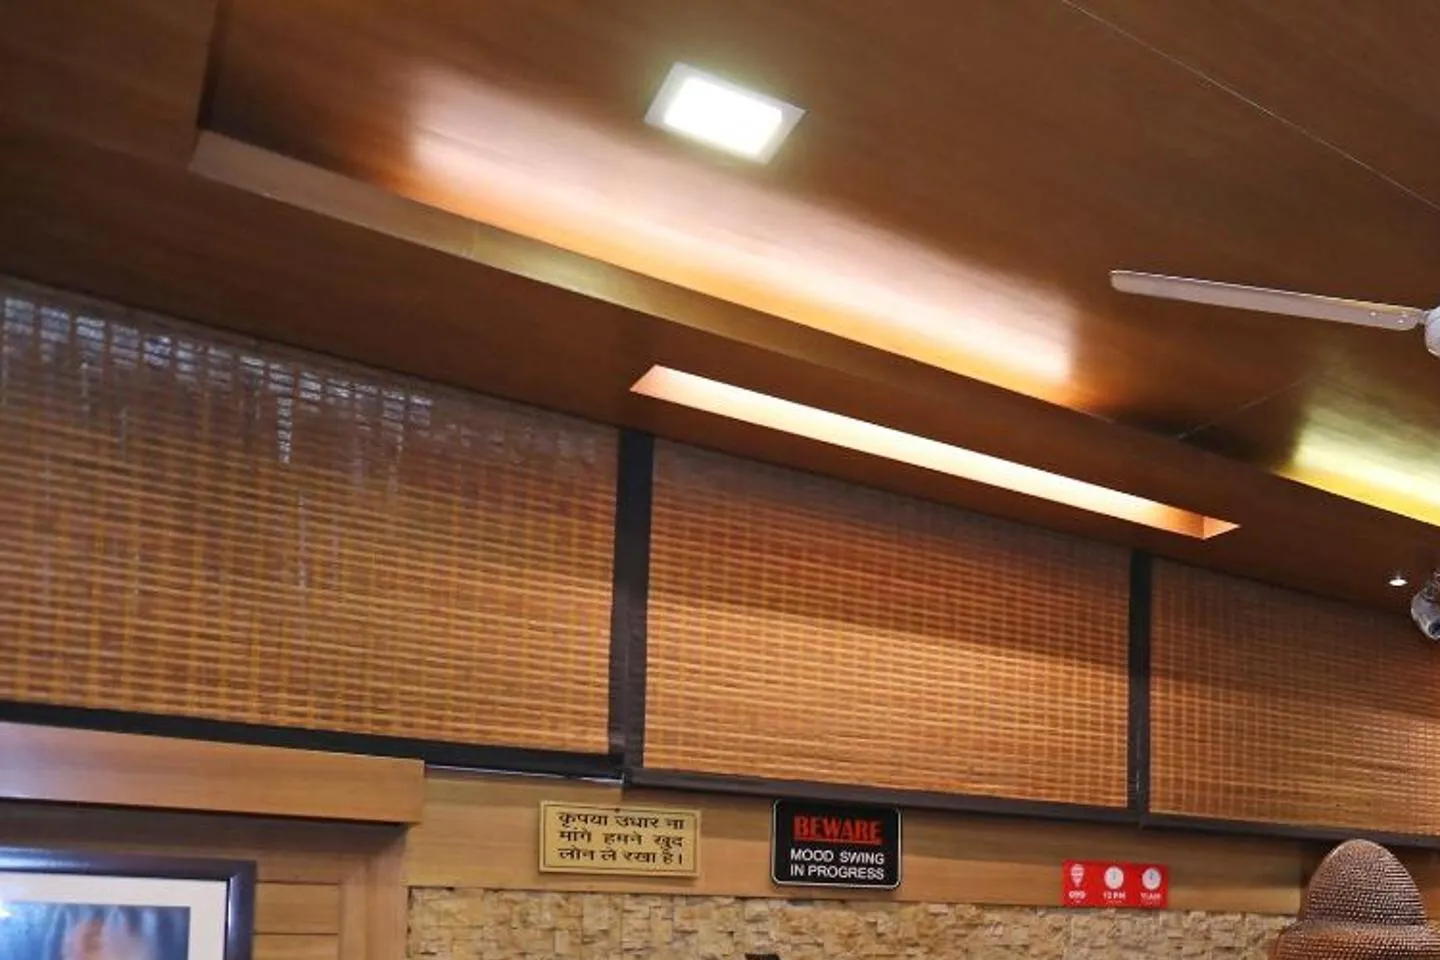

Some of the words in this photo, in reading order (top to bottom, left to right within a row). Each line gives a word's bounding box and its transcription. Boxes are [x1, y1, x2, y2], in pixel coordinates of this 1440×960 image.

[558, 811, 608, 828] कृपया
[614, 815, 659, 828] उधार
[792, 814, 882, 842] BEWARE
[602, 831, 643, 846] हमने
[651, 834, 684, 849] खुद
[558, 844, 595, 861] लोन
[599, 846, 617, 861] ले
[622, 851, 656, 864] रखा
[790, 847, 834, 863] MOOD
[839, 850, 885, 866] SWING
[790, 863, 806, 877] IN
[807, 864, 885, 881] PROGRESS
